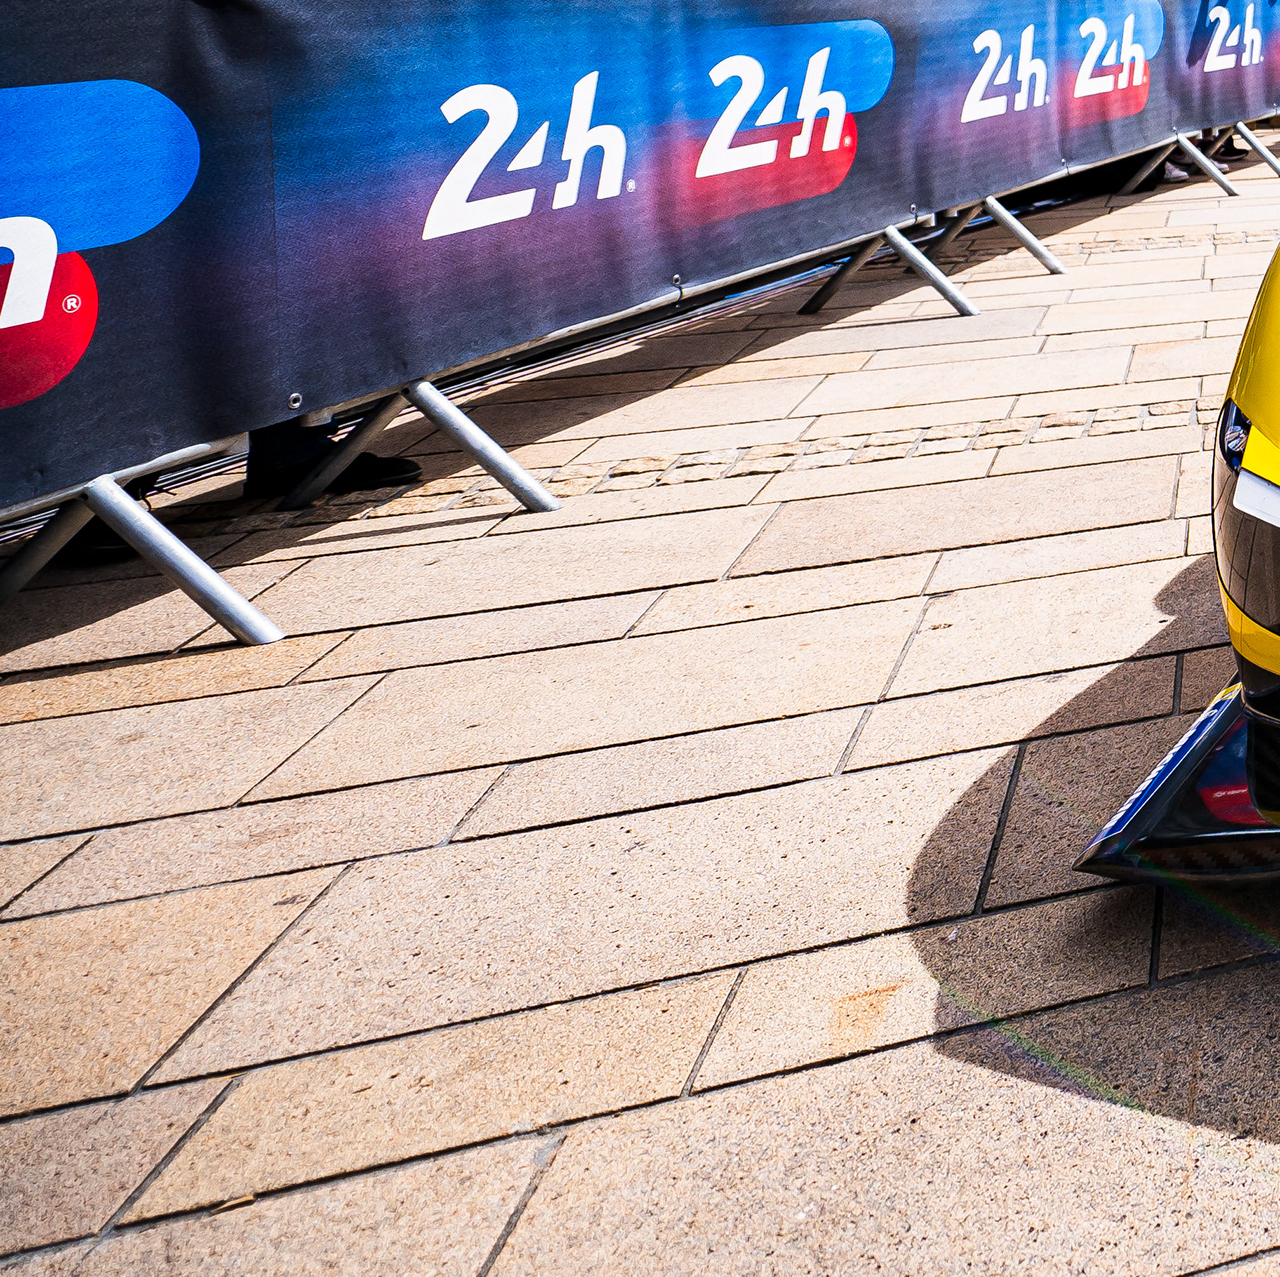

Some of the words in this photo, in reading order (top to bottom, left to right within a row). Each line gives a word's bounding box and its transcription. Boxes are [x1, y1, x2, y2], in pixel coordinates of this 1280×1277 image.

[960, 23, 1048, 123] 24h
[1073, 13, 1146, 99] 24h
[1203, 3, 1263, 72] 24h
[422, 71, 628, 241] 24h
[695, 46, 848, 179] 24h
